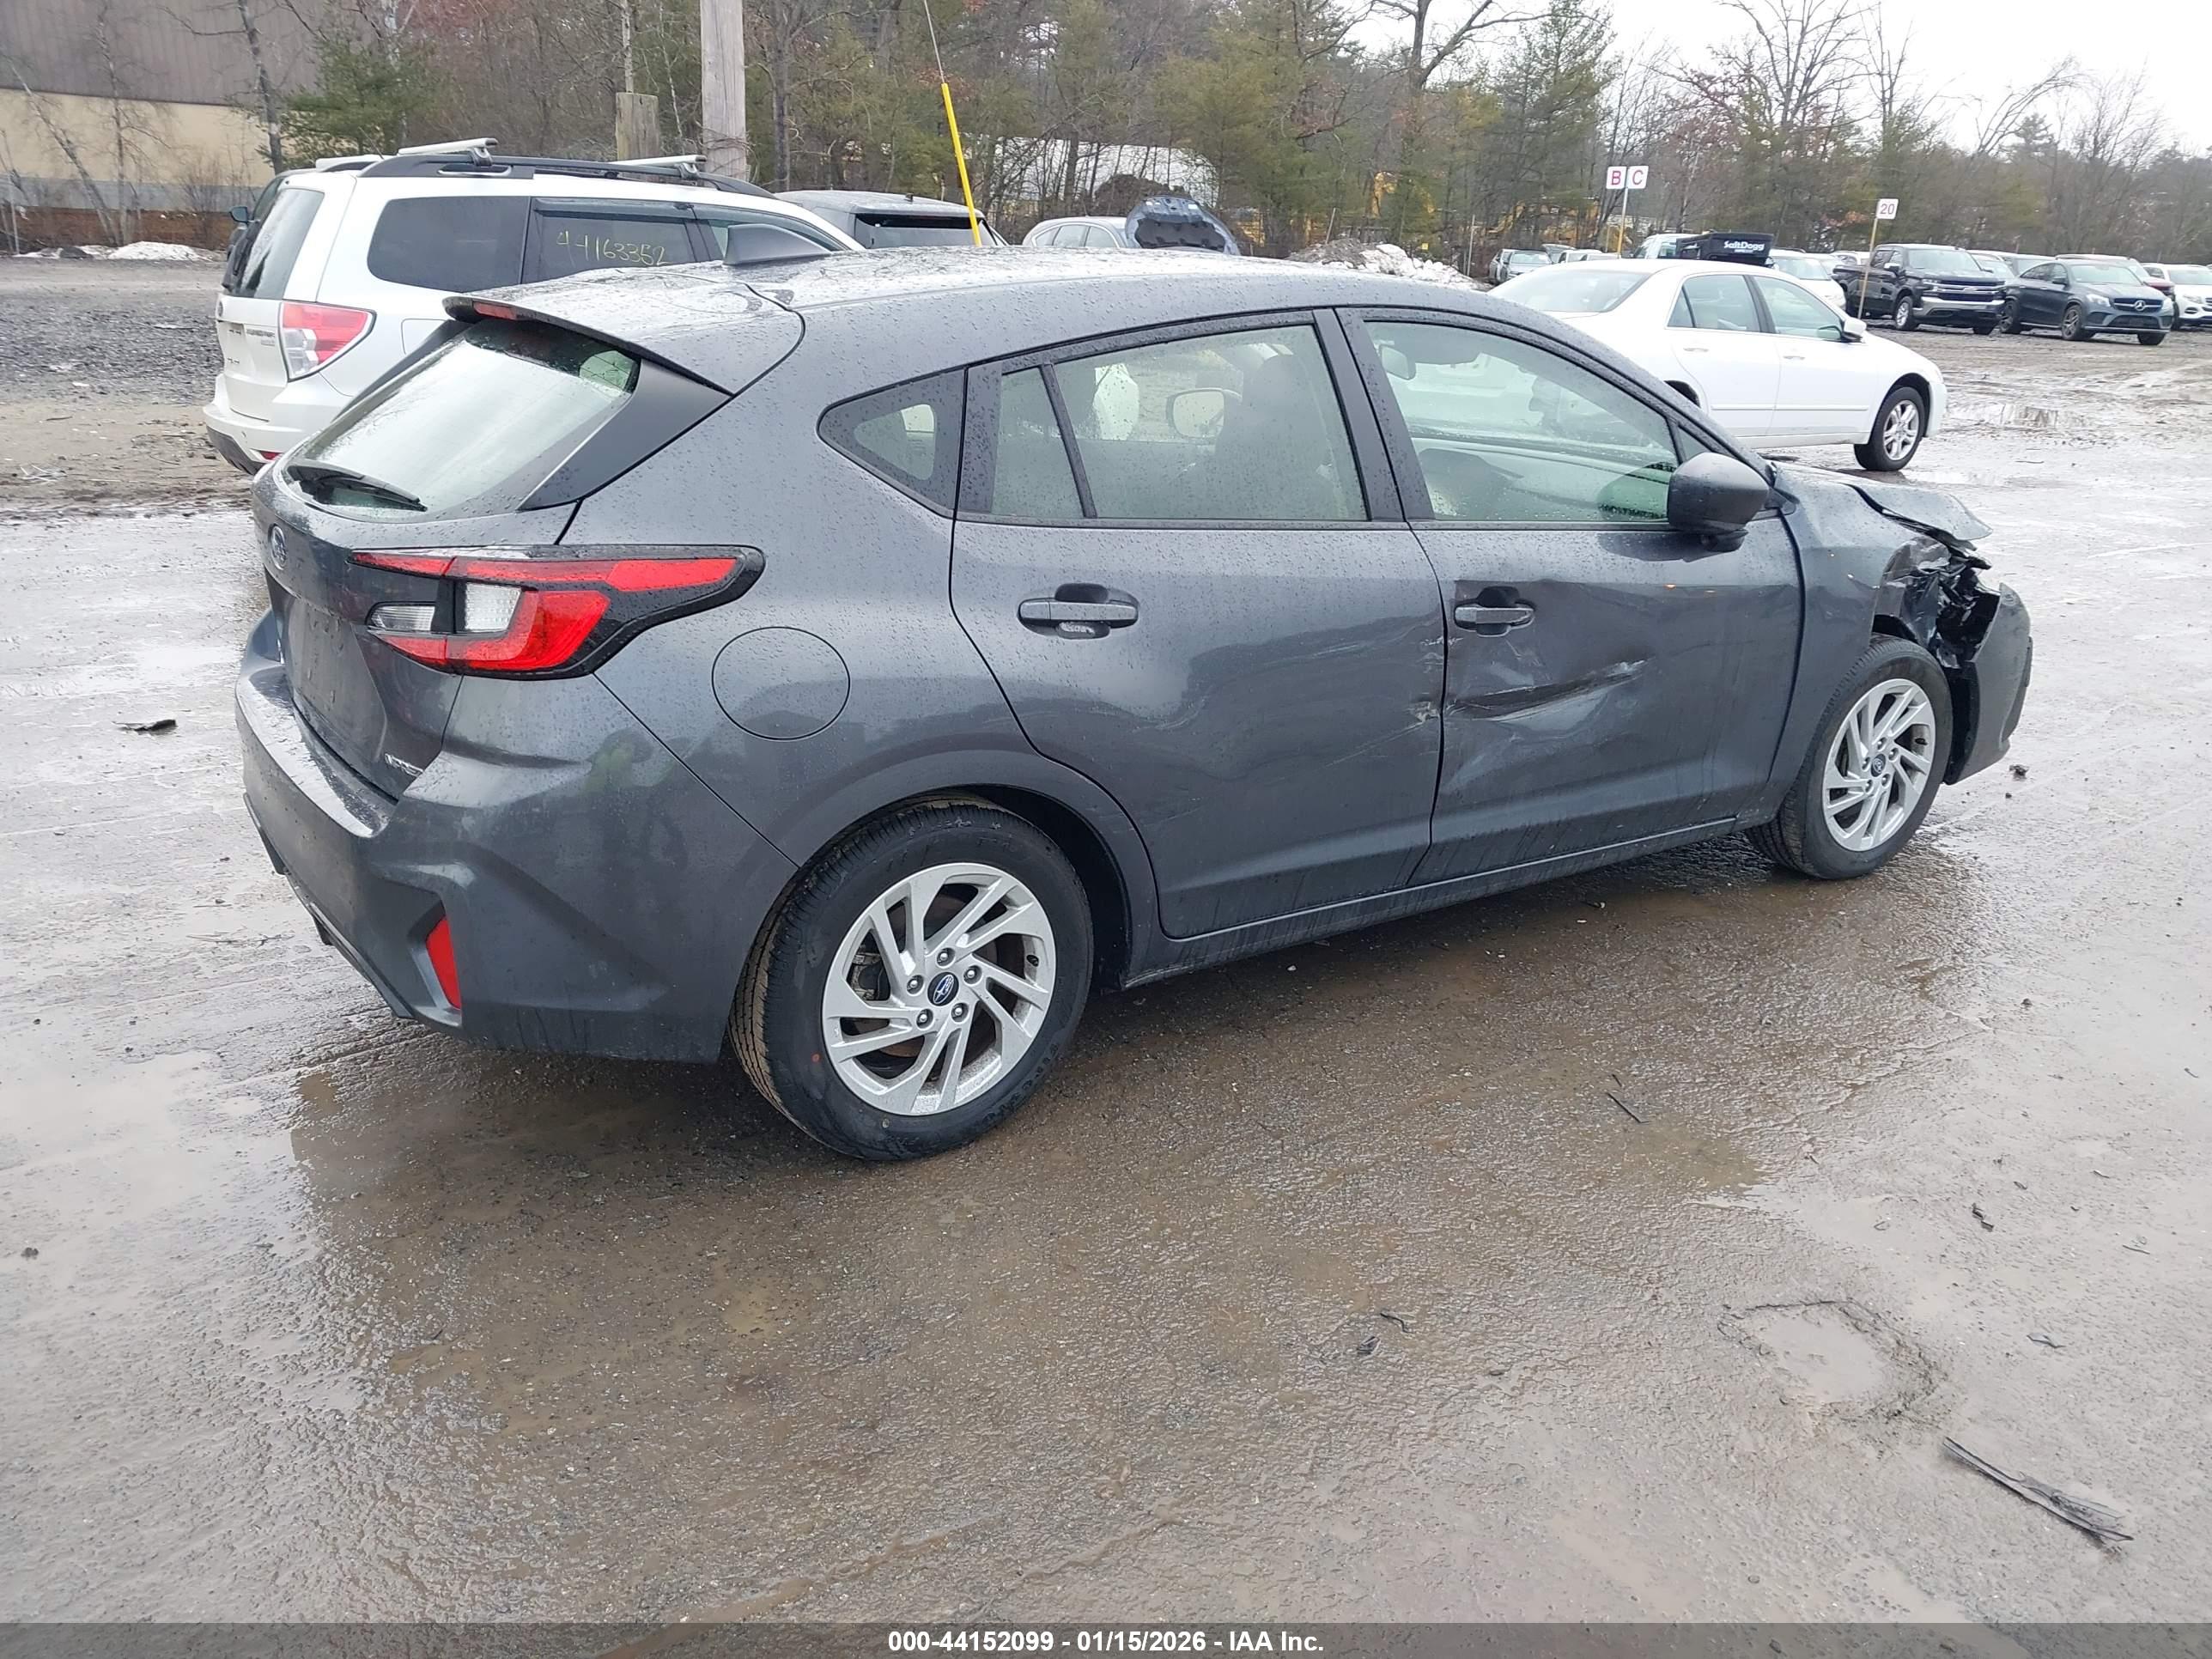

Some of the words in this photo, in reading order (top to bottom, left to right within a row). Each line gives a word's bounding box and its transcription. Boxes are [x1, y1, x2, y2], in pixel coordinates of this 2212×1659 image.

[1611, 170, 1622, 185] B
[1632, 169, 1644, 185] C
[1879, 203, 1895, 215] 20
[556, 230, 673, 268] 44163352
[1723, 240, 1765, 252] SaltDogg
